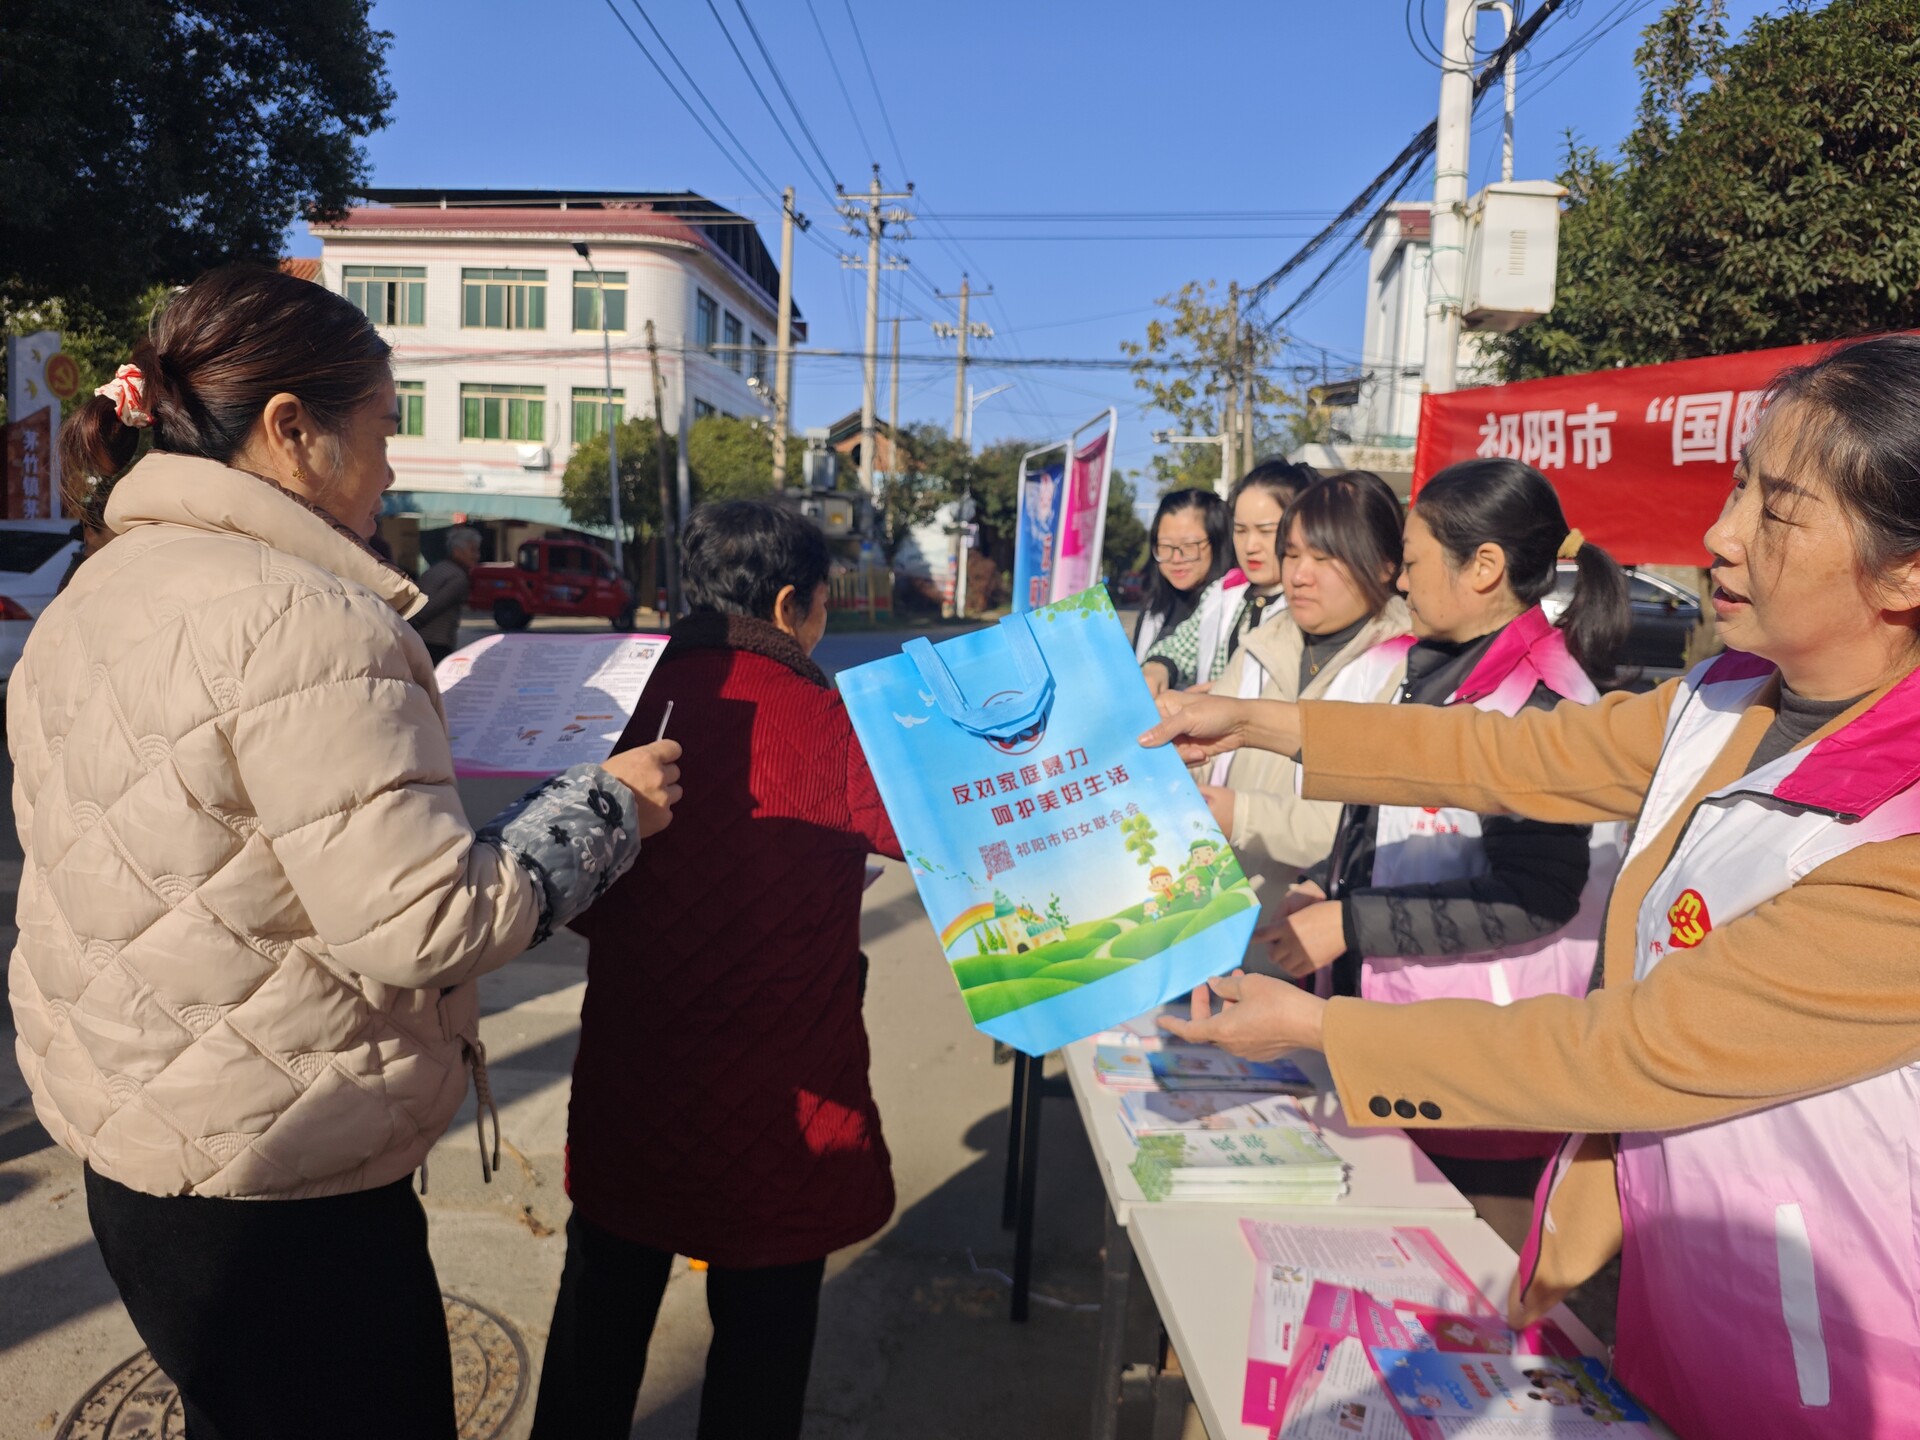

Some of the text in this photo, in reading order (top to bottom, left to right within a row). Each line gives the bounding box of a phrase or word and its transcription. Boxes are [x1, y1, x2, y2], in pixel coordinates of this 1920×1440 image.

[952, 747, 1089, 805] 反对家庭暴力
[991, 764, 1130, 826] 呵护美好生活
[1015, 801, 1140, 858] 祁阳市妇女联合会
